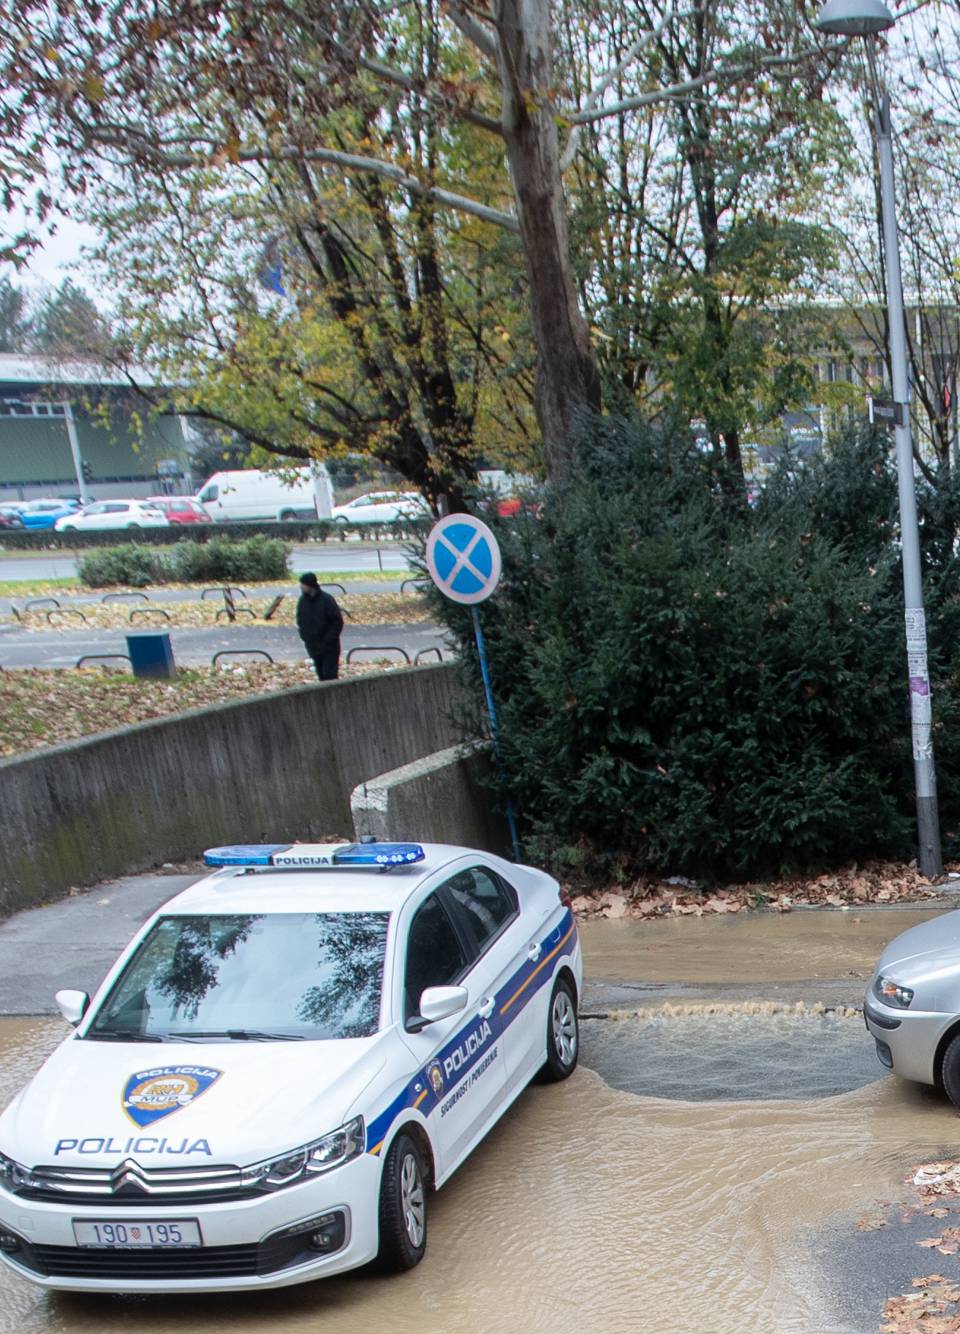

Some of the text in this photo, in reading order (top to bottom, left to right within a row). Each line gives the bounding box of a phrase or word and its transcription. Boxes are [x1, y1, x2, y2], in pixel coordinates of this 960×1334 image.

[276, 857, 329, 865] POLICIJA
[443, 1020, 492, 1080] POLICIJA
[136, 1066, 219, 1080] POLICIJA
[141, 1095, 179, 1103] MUP
[441, 1080, 469, 1117] SIGURNOST
[54, 1137, 212, 1156] POLICIJA
[93, 1224, 182, 1244] 190 195
